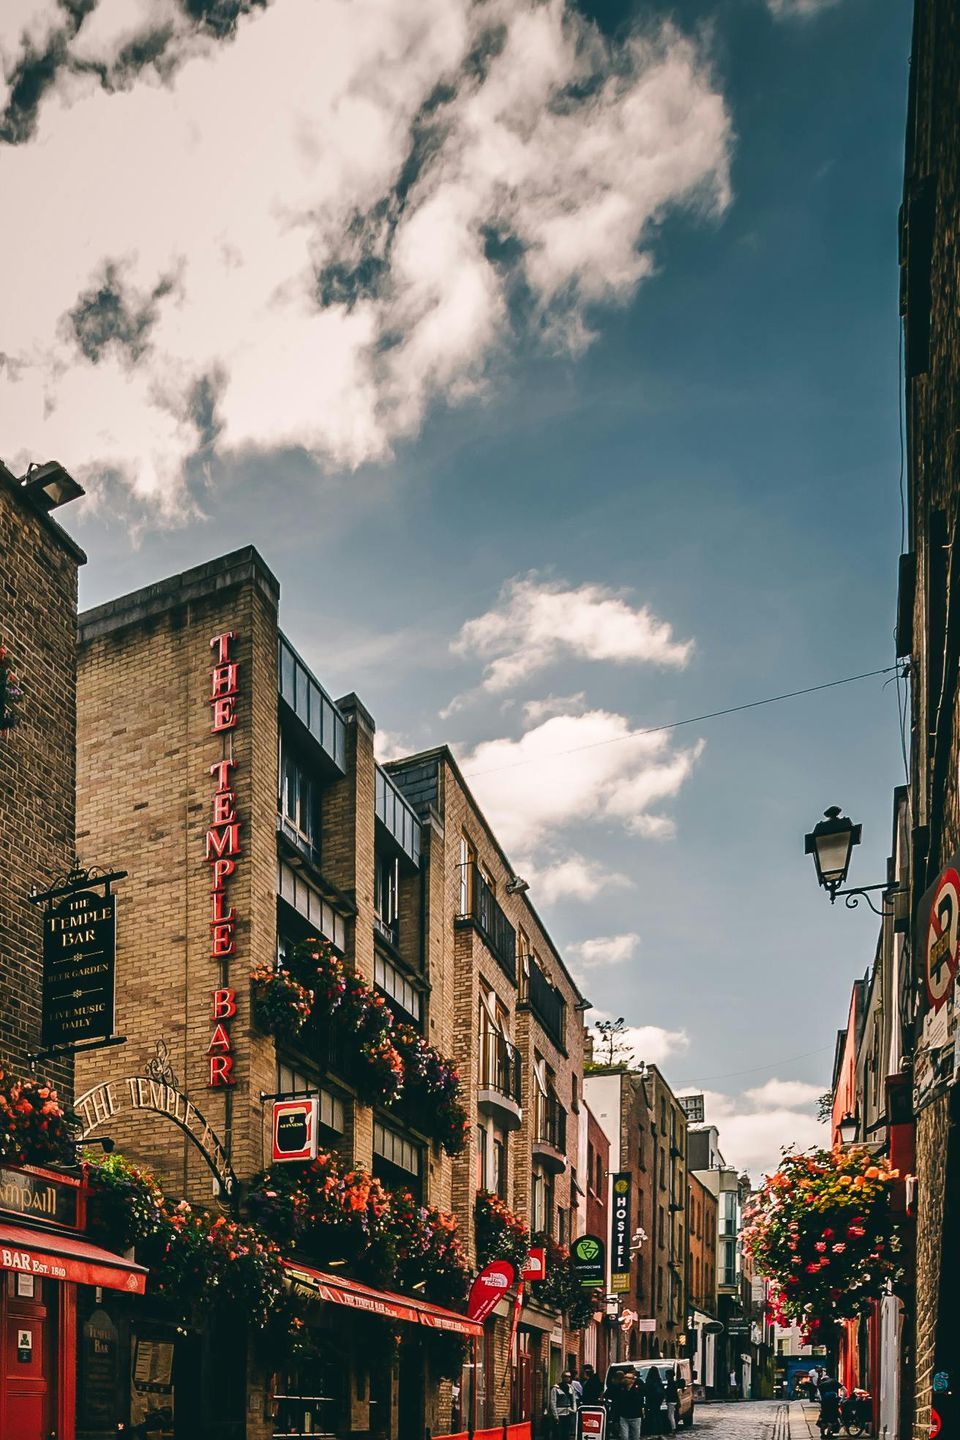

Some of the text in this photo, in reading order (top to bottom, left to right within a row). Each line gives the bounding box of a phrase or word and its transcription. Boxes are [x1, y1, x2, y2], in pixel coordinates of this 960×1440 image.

[209, 631, 240, 735] THE
[206, 758, 241, 959] TEMPLE
[68, 898, 90, 911] THE
[48, 907, 112, 932] TEMPLE
[62, 929, 96, 947] BAR
[72, 963, 109, 978] GARDEN
[73, 1002, 106, 1017] MUSIC
[61, 1017, 92, 1031] DAILY
[207, 988, 237, 1087] BAR
[80, 1083, 121, 1129] THE
[127, 1077, 194, 1130] TEMPLE
[616, 1197, 627, 1268] HOSTEL
[2, 1249, 31, 1271] BAR
[51, 1266, 66, 1278] 1840
